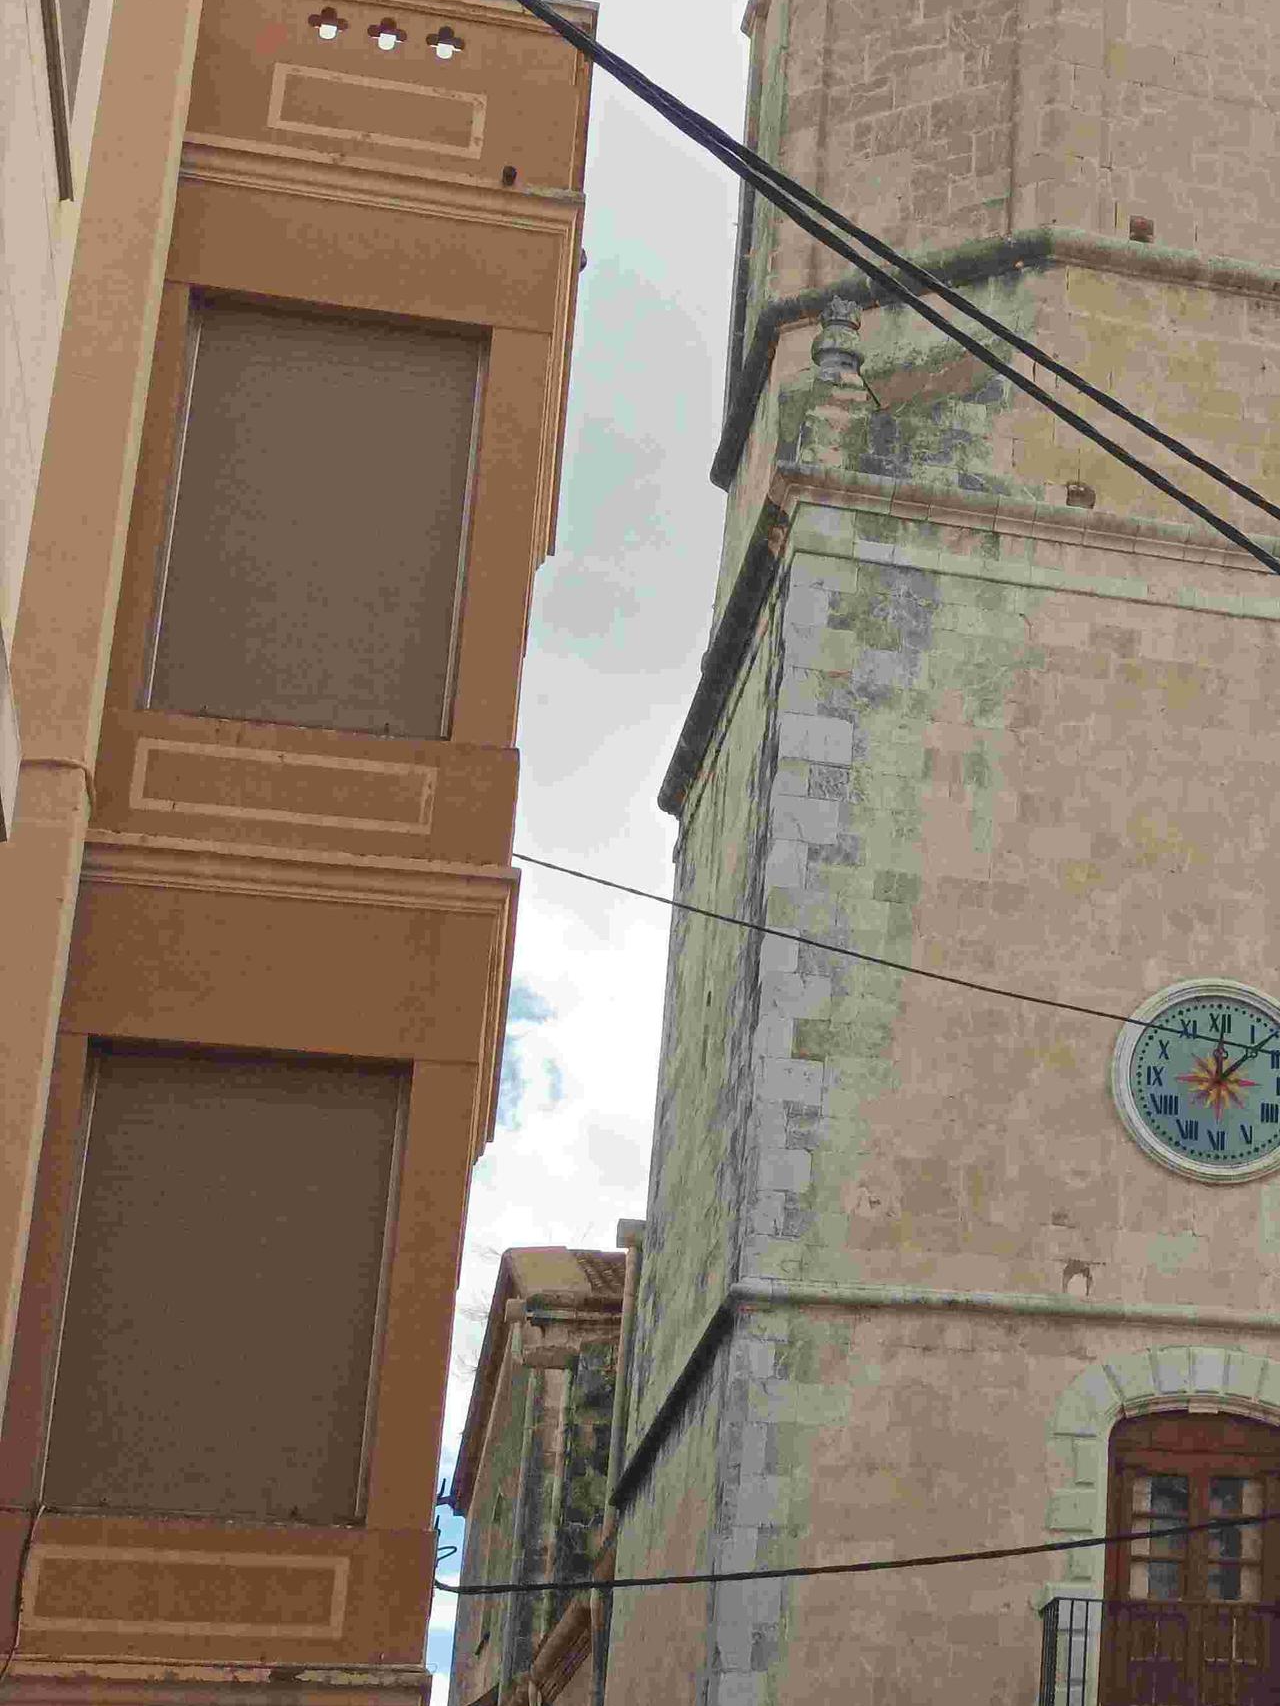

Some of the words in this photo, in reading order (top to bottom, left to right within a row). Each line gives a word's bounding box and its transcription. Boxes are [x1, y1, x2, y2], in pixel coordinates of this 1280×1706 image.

[1180, 1020, 1197, 1038] XI
[1209, 1013, 1232, 1033] XII
[1159, 1040, 1170, 1060] X
[1146, 1066, 1163, 1087] IX
[1150, 1094, 1178, 1115] VIII
[1260, 1103, 1279, 1123] IIII
[1176, 1119, 1198, 1140] VII
[1240, 1125, 1253, 1144] V
[1208, 1130, 1225, 1150] VI
